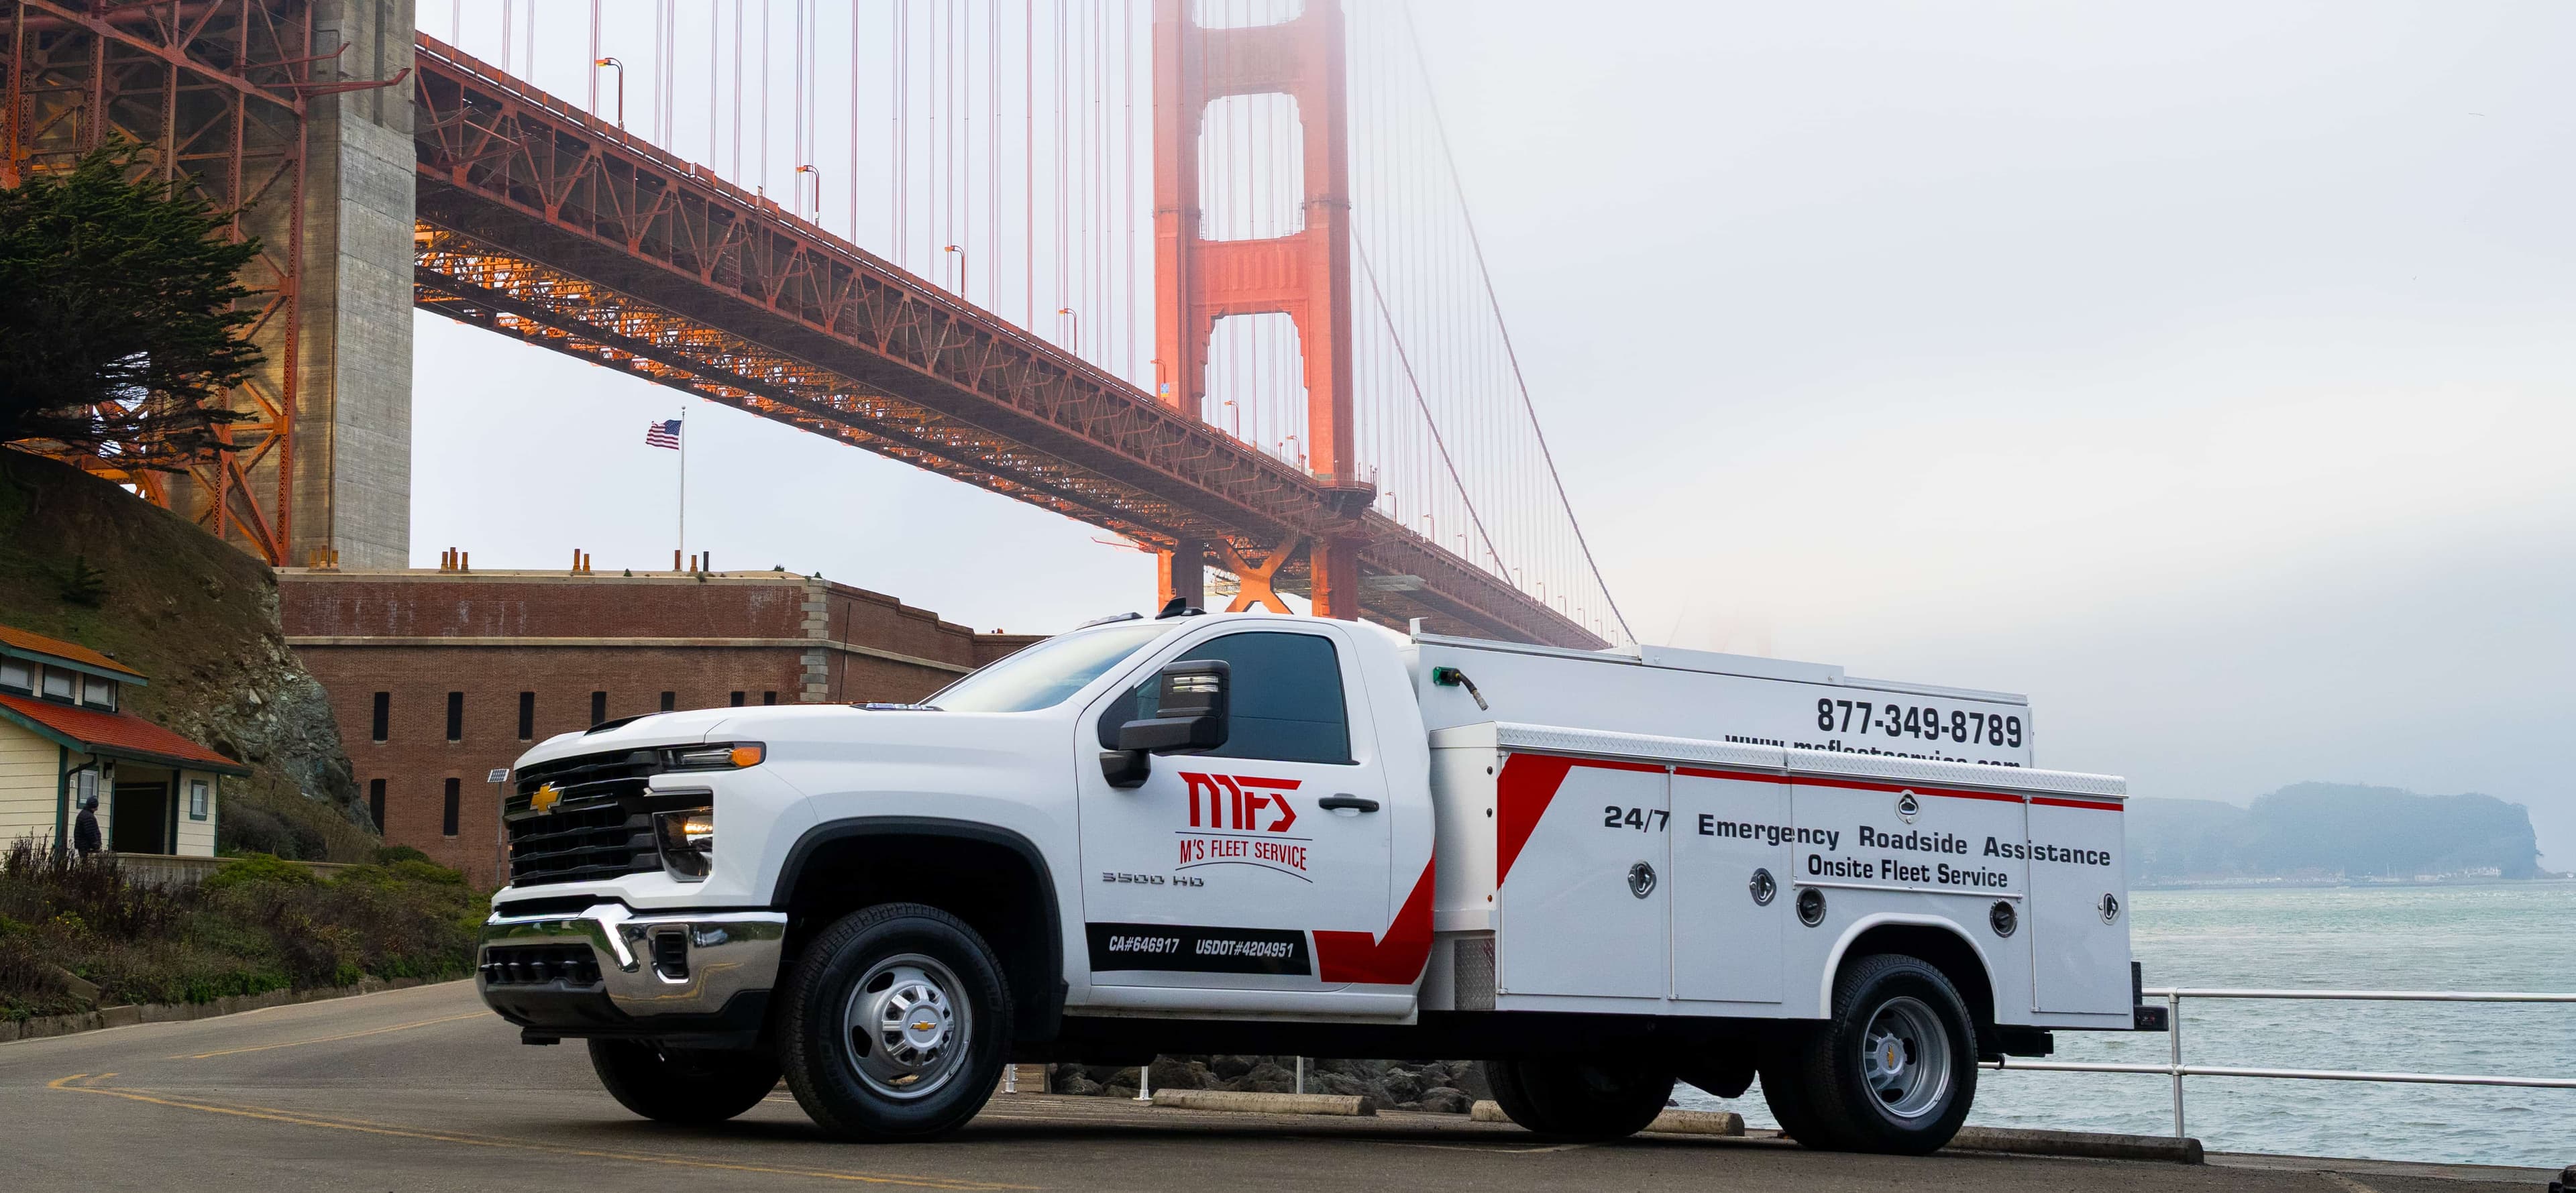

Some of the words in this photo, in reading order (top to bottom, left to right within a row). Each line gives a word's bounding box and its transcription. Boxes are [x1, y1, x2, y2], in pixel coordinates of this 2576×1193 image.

[1817, 697, 2022, 748] 877-349-8789
[1177, 771, 1303, 833] MFS
[1604, 805, 1670, 833] 24/7
[1698, 813, 1840, 852] Emergency
[1859, 826, 1968, 855] Roadside
[1983, 836, 2111, 866] Assistance
[1180, 839, 1205, 864] M'S
[1212, 840, 1249, 858] FLEET
[1254, 842, 1307, 871] SERVICE
[1808, 854, 1874, 879] Onsite
[1881, 858, 1931, 884] Fleet
[1937, 863, 2008, 888] Service
[1102, 872, 1165, 885] 3500
[1173, 875, 1204, 887] HD
[1109, 935, 1179, 954] CA#646917
[1195, 939, 1293, 958] USDOT#4204951
